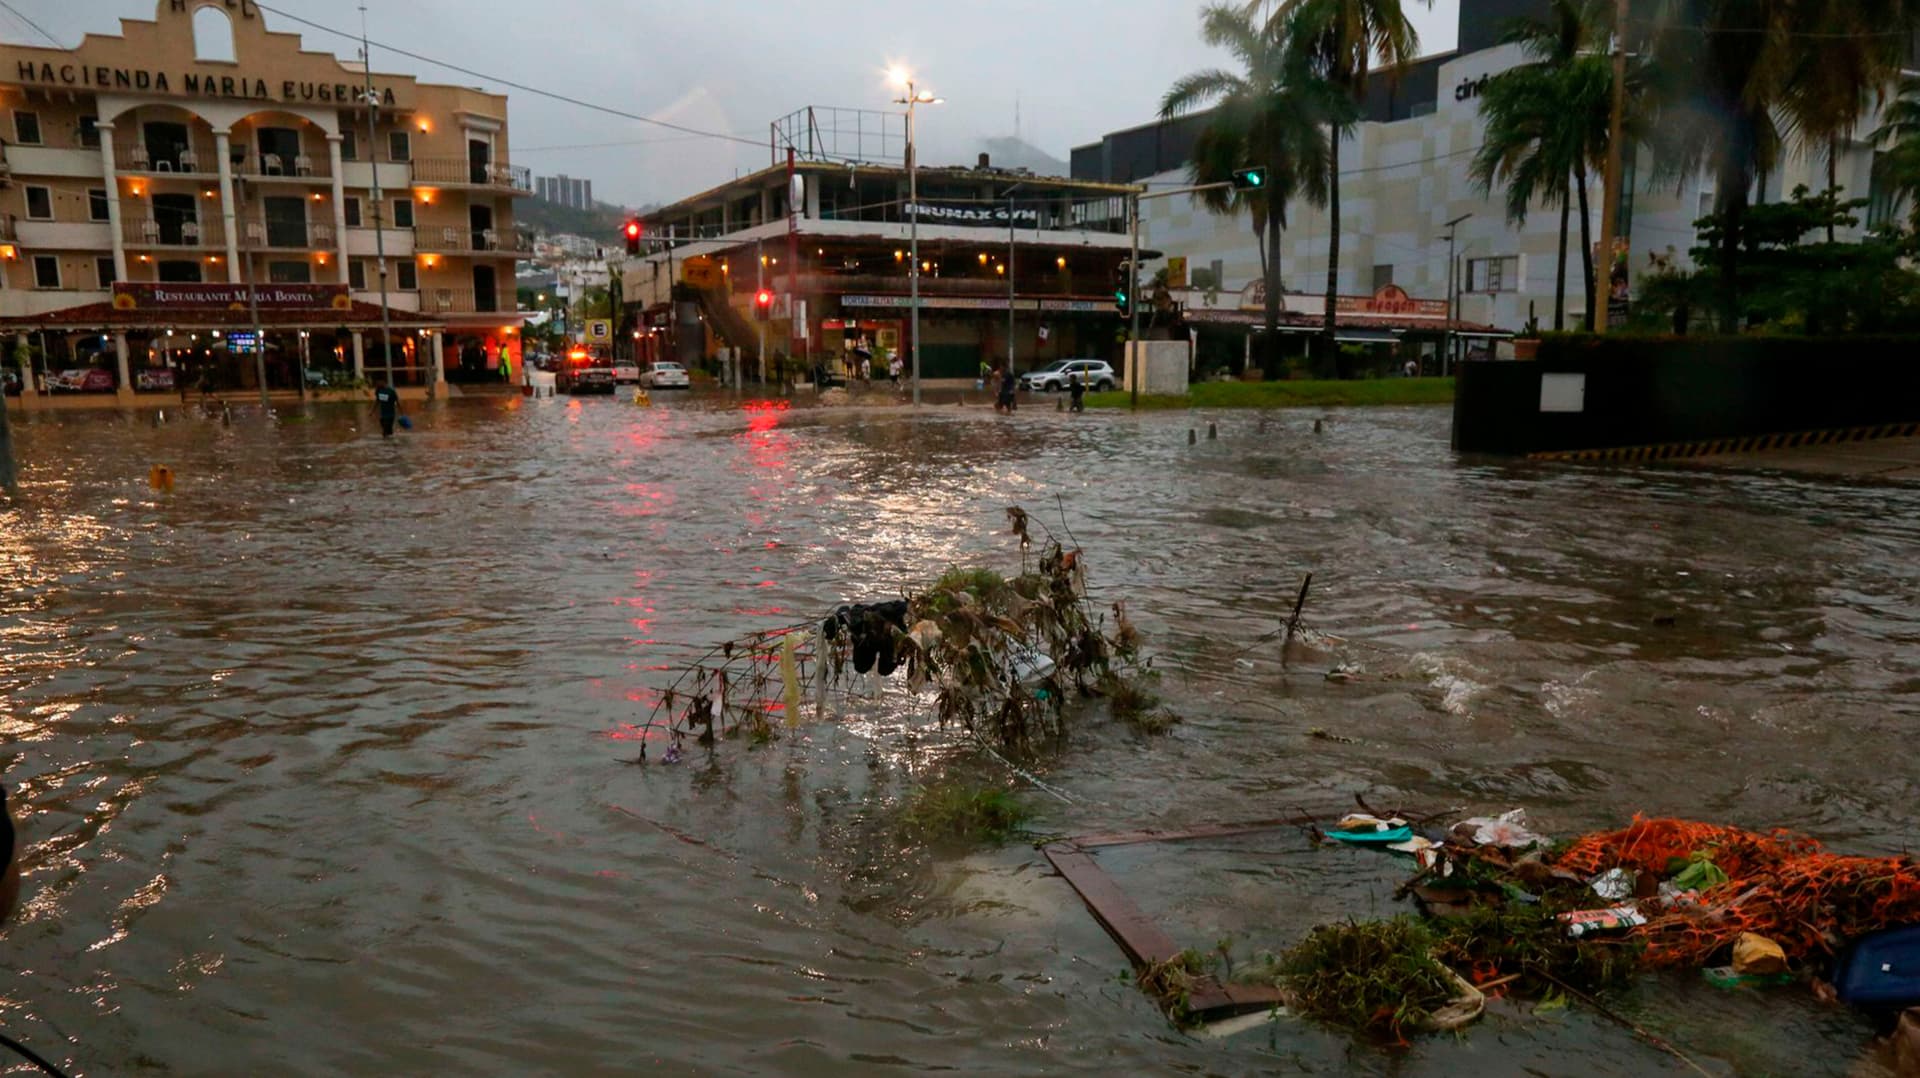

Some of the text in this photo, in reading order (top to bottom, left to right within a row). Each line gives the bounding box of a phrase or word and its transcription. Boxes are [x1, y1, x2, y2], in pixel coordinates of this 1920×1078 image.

[17, 60, 396, 105] HACIENDA MARIA EUGENA
[594, 324, 604, 335] E
